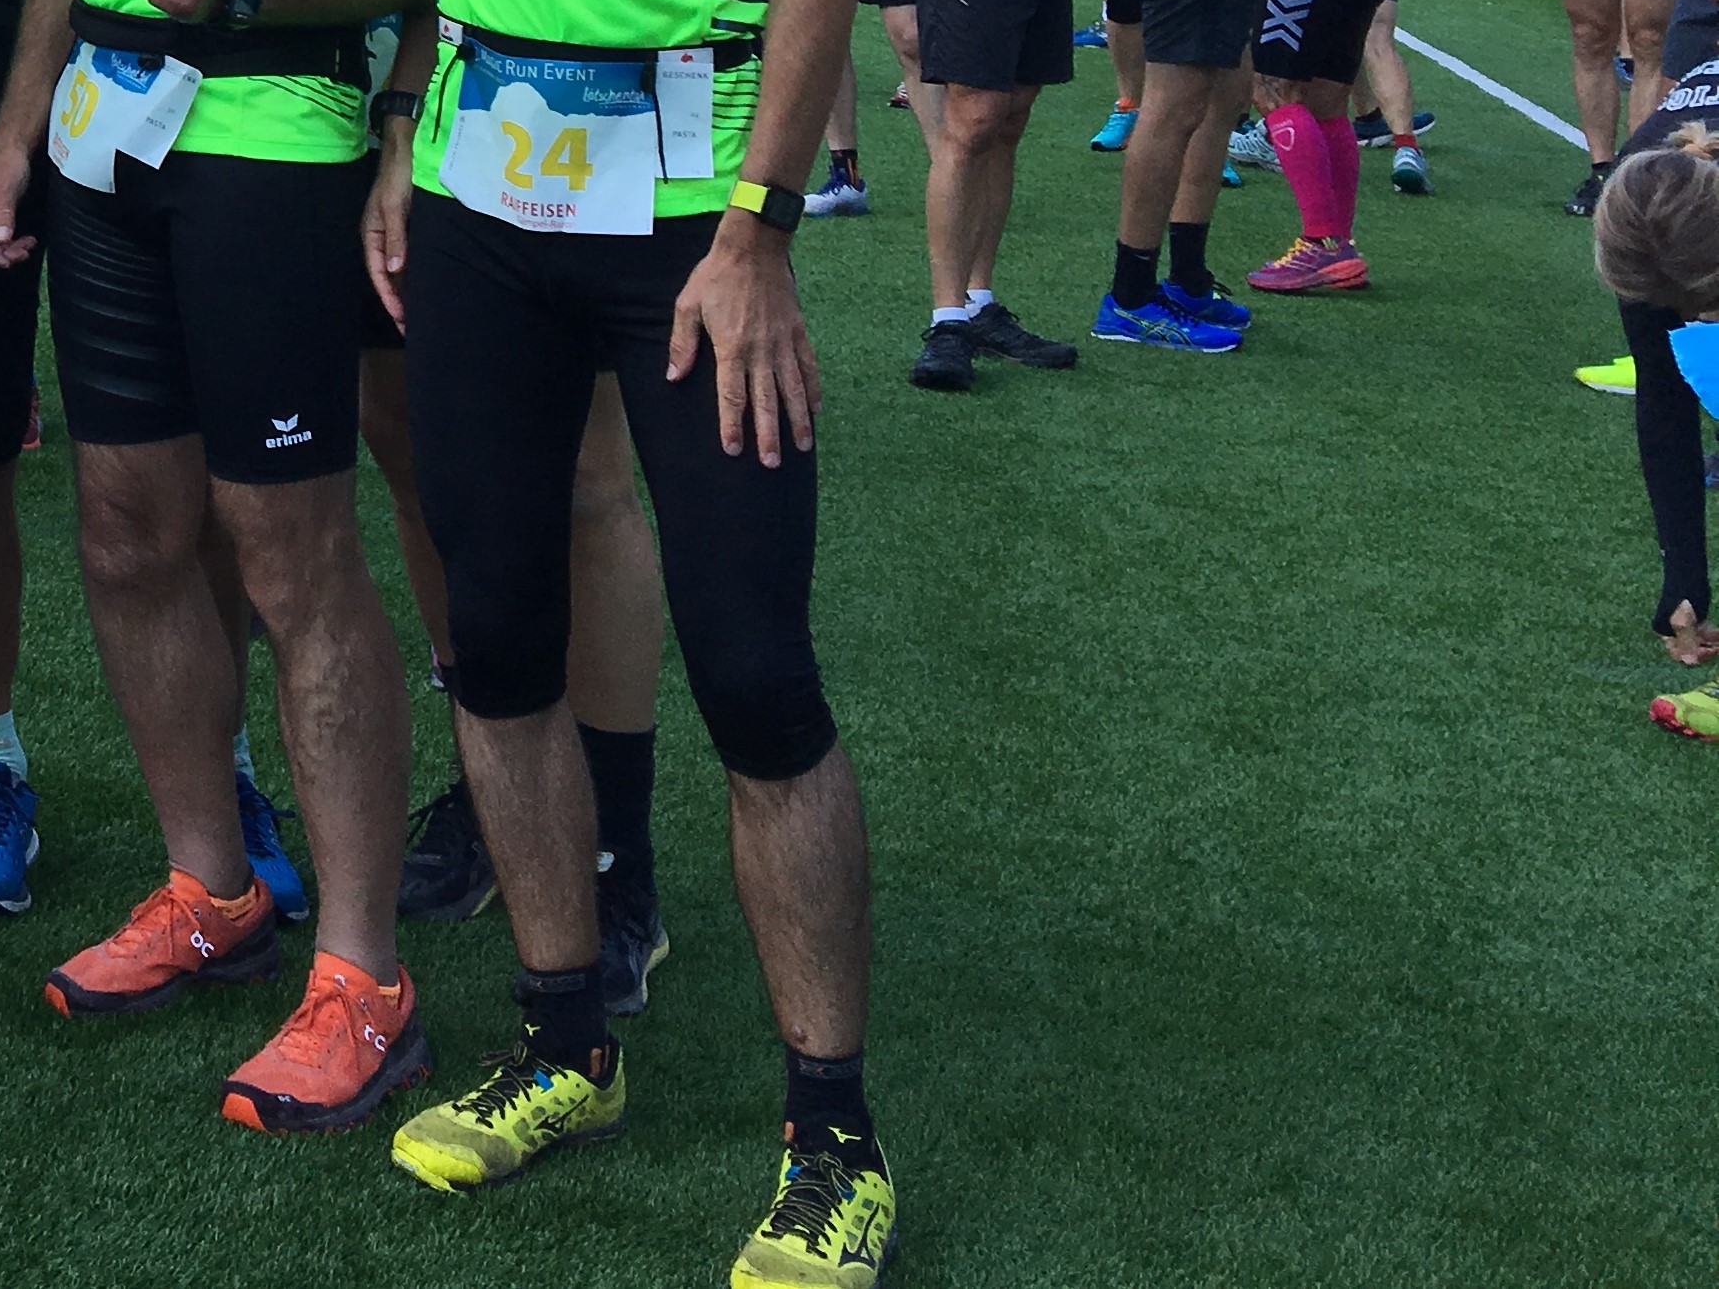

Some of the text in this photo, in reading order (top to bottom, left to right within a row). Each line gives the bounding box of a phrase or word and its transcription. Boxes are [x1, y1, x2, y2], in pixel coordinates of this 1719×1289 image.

[505, 61, 538, 80] RUN
[543, 62, 596, 82] EVENT
[61, 69, 100, 139] 50
[500, 120, 595, 193] 24
[500, 191, 577, 219] RAIFFEISEN
[266, 430, 313, 449] erima
